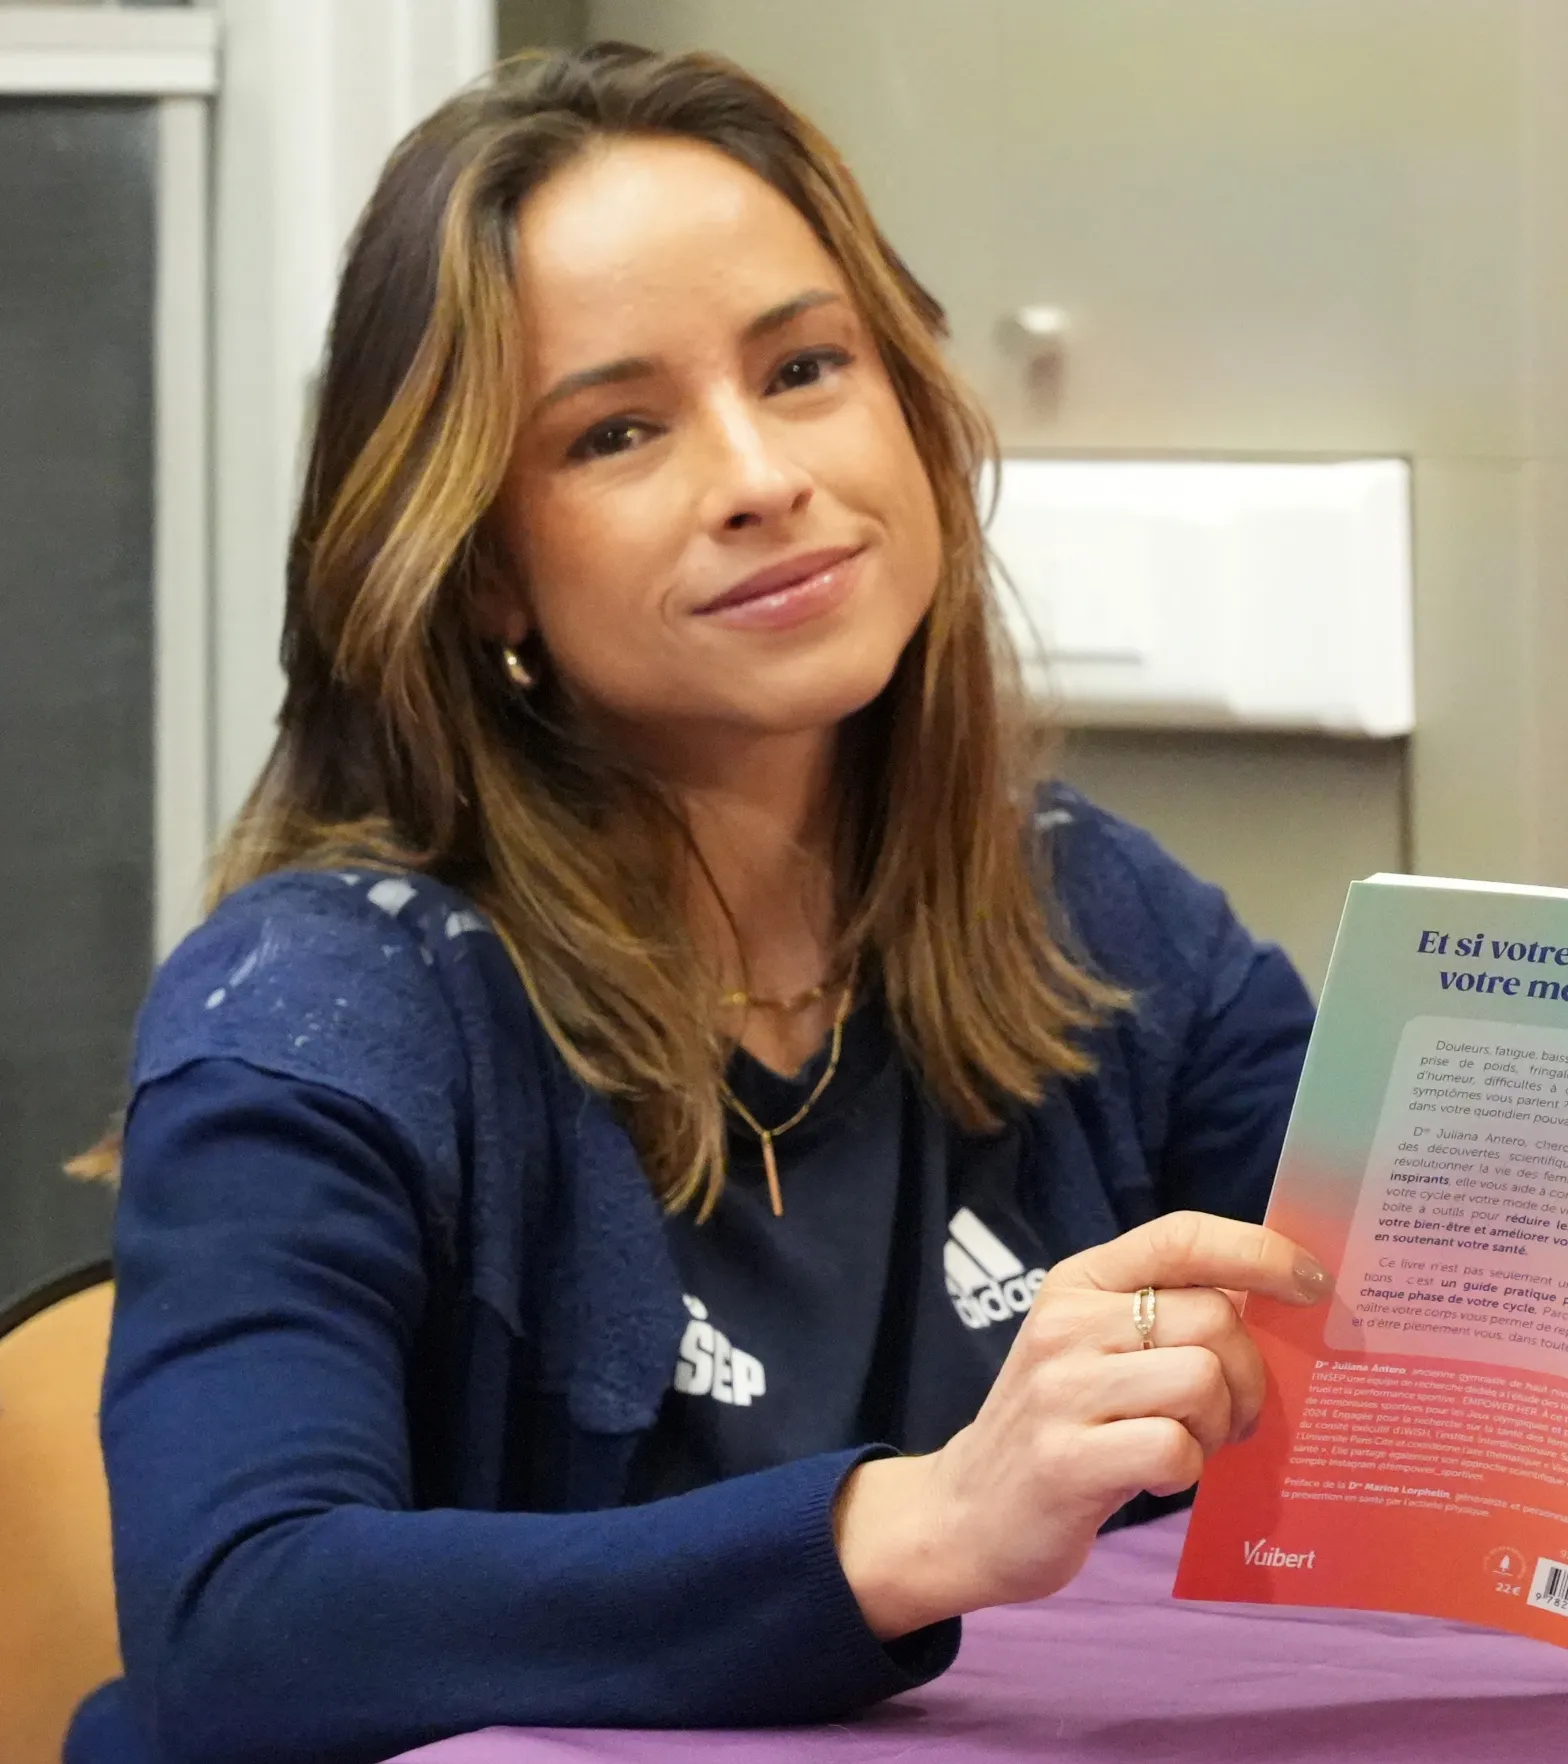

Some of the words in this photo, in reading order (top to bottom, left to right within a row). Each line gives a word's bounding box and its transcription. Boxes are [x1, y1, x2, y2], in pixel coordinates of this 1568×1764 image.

[1417, 930, 1449, 954] Et
[1454, 934, 1484, 957] si
[1440, 971, 1520, 995] votre
[1419, 1055, 1449, 1066] prise
[1458, 1058, 1474, 1068] de
[1483, 1075, 1542, 1091] difficultés
[1549, 1083, 1557, 1093] à
[1412, 1086, 1481, 1100] symptômes
[1485, 1093, 1512, 1104] vous
[1515, 1096, 1559, 1108] parlent
[1408, 1100, 1436, 1111] dans
[1440, 1104, 1471, 1115] votre
[1473, 1107, 1530, 1120] quotidien
[1435, 1127, 1478, 1141] Juliana
[1484, 1132, 1528, 1147] Antero,
[1455, 1176, 1476, 1188] elle
[1479, 1180, 1507, 1191] vous
[1511, 1183, 1536, 1195] aide
[1381, 1201, 1412, 1212] boîte
[1431, 1206, 1464, 1216] outils
[1470, 1210, 1500, 1220] pour
[1505, 1213, 1550, 1227] réduire
[1378, 1217, 1410, 1228] votre
[1413, 1219, 1470, 1233] bien-être
[1473, 1225, 1487, 1235] et
[1488, 1228, 1549, 1243] améliorer
[1373, 1233, 1390, 1242] en
[1392, 1234, 1454, 1246] soutenant
[1456, 1239, 1489, 1250] votre
[1242, 1538, 1317, 1569] Vuibert
